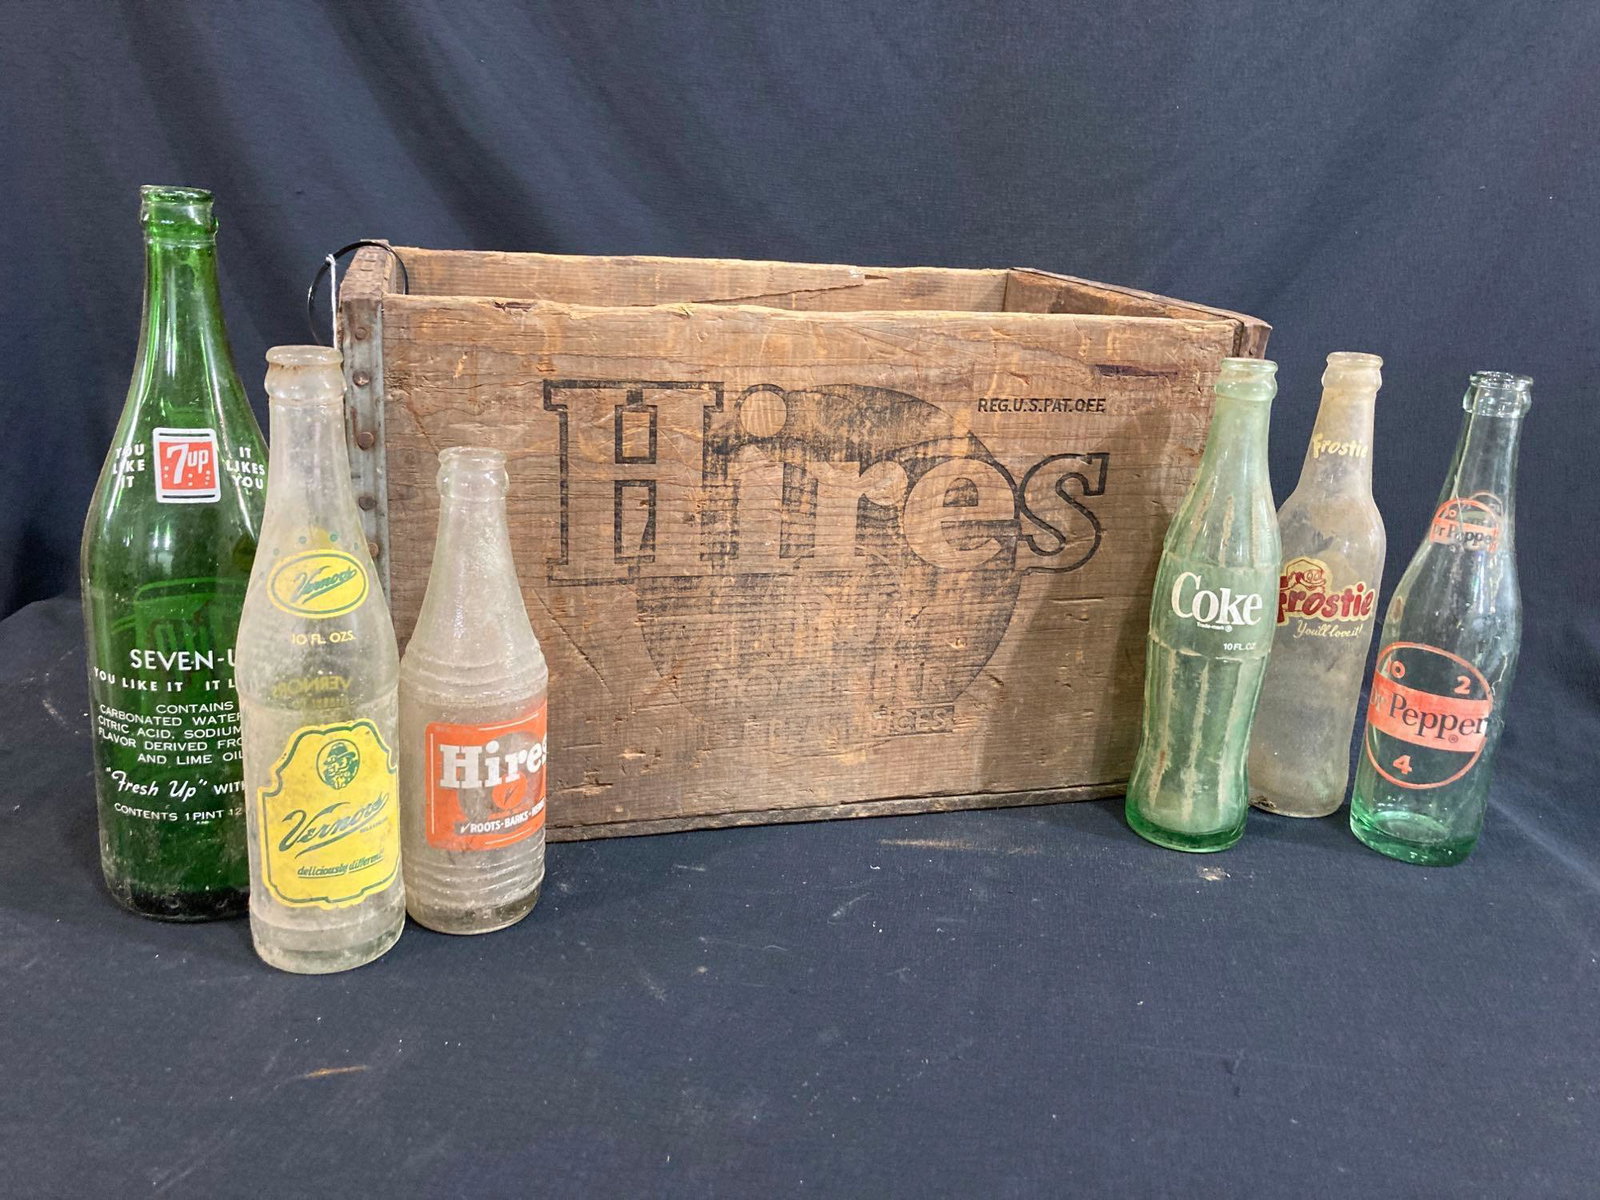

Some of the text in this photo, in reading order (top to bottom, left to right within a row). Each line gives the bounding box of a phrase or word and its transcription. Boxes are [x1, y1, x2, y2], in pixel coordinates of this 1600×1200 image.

[115, 443, 145, 459] YOU
[239, 446, 252, 458] IT
[1313, 433, 1368, 458] Frostie
[112, 459, 146, 474] LIKE
[226, 460, 265, 475] LIKES
[232, 475, 264, 490] YOU
[543, 379, 1110, 586] Hires
[1447, 523, 1493, 547] Peppe
[290, 565, 358, 605] Vernors
[1171, 571, 1263, 626] Coke
[292, 633, 306, 646] 10
[1329, 624, 1350, 638] love
[93, 667, 116, 684] YOU
[121, 677, 158, 692] LIKE
[167, 681, 184, 692] IT
[205, 680, 221, 691] IT
[1454, 675, 1471, 695] 2
[99, 703, 183, 726] CARBONATED
[156, 701, 234, 714] CONTAINS
[1389, 692, 1489, 740] Pepper
[97, 715, 130, 734] CITRIC
[184, 725, 242, 739] SODIUM
[98, 726, 137, 748] FLAVOR
[144, 740, 208, 751] DERIVED
[137, 752, 167, 765] AND
[176, 753, 213, 765] LIME
[1393, 754, 1413, 775] 4
[114, 802, 179, 821] CONTENTS
[229, 807, 243, 816] 12
[278, 792, 389, 860] Vernors
